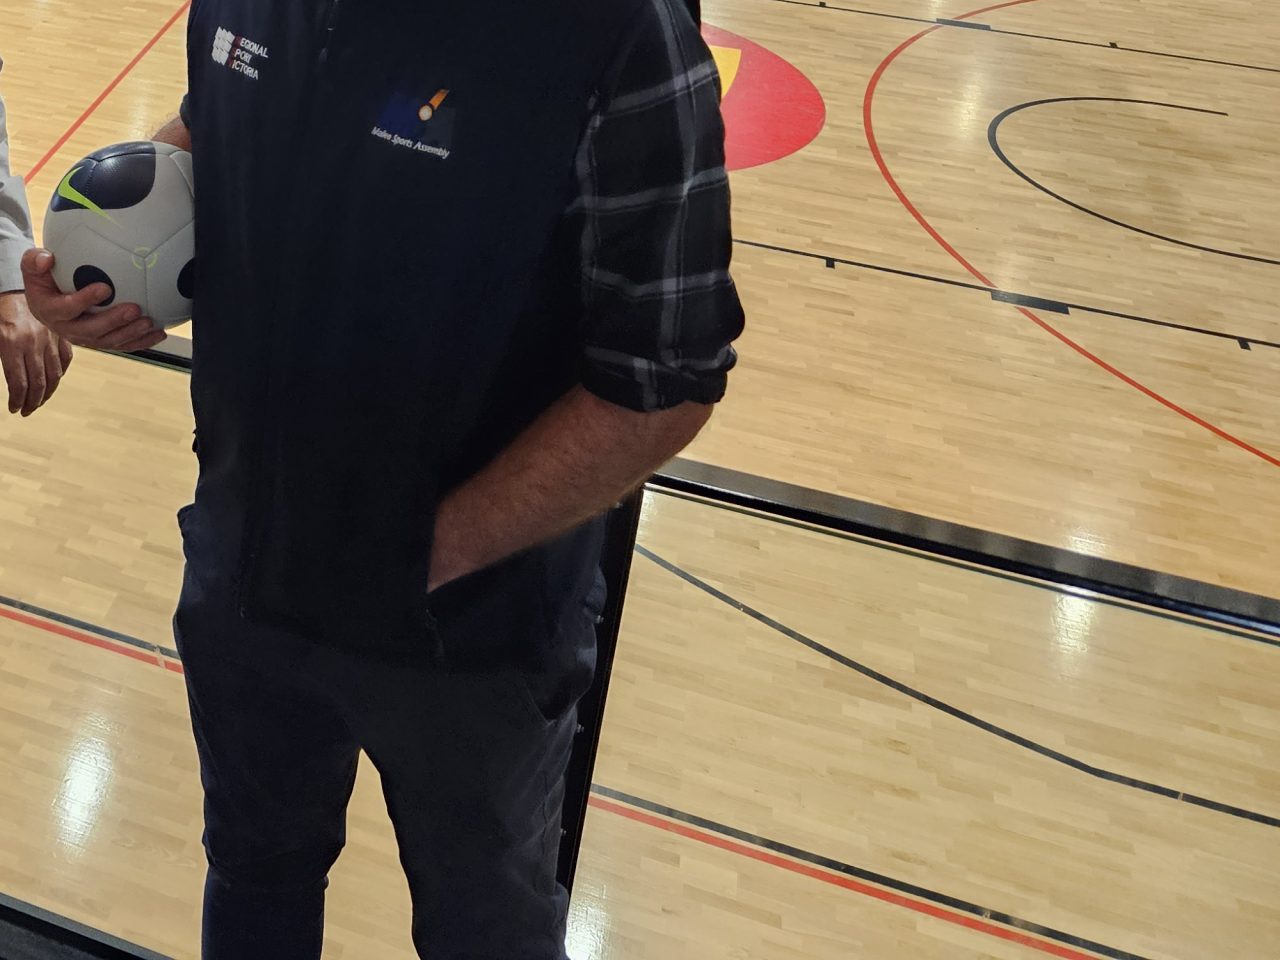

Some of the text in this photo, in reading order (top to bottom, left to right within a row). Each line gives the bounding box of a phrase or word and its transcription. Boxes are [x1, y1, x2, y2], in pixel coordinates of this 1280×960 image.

[234, 35, 269, 58] EGIONAL
[391, 134, 414, 146] Sports
[412, 141, 451, 160] Assembly
